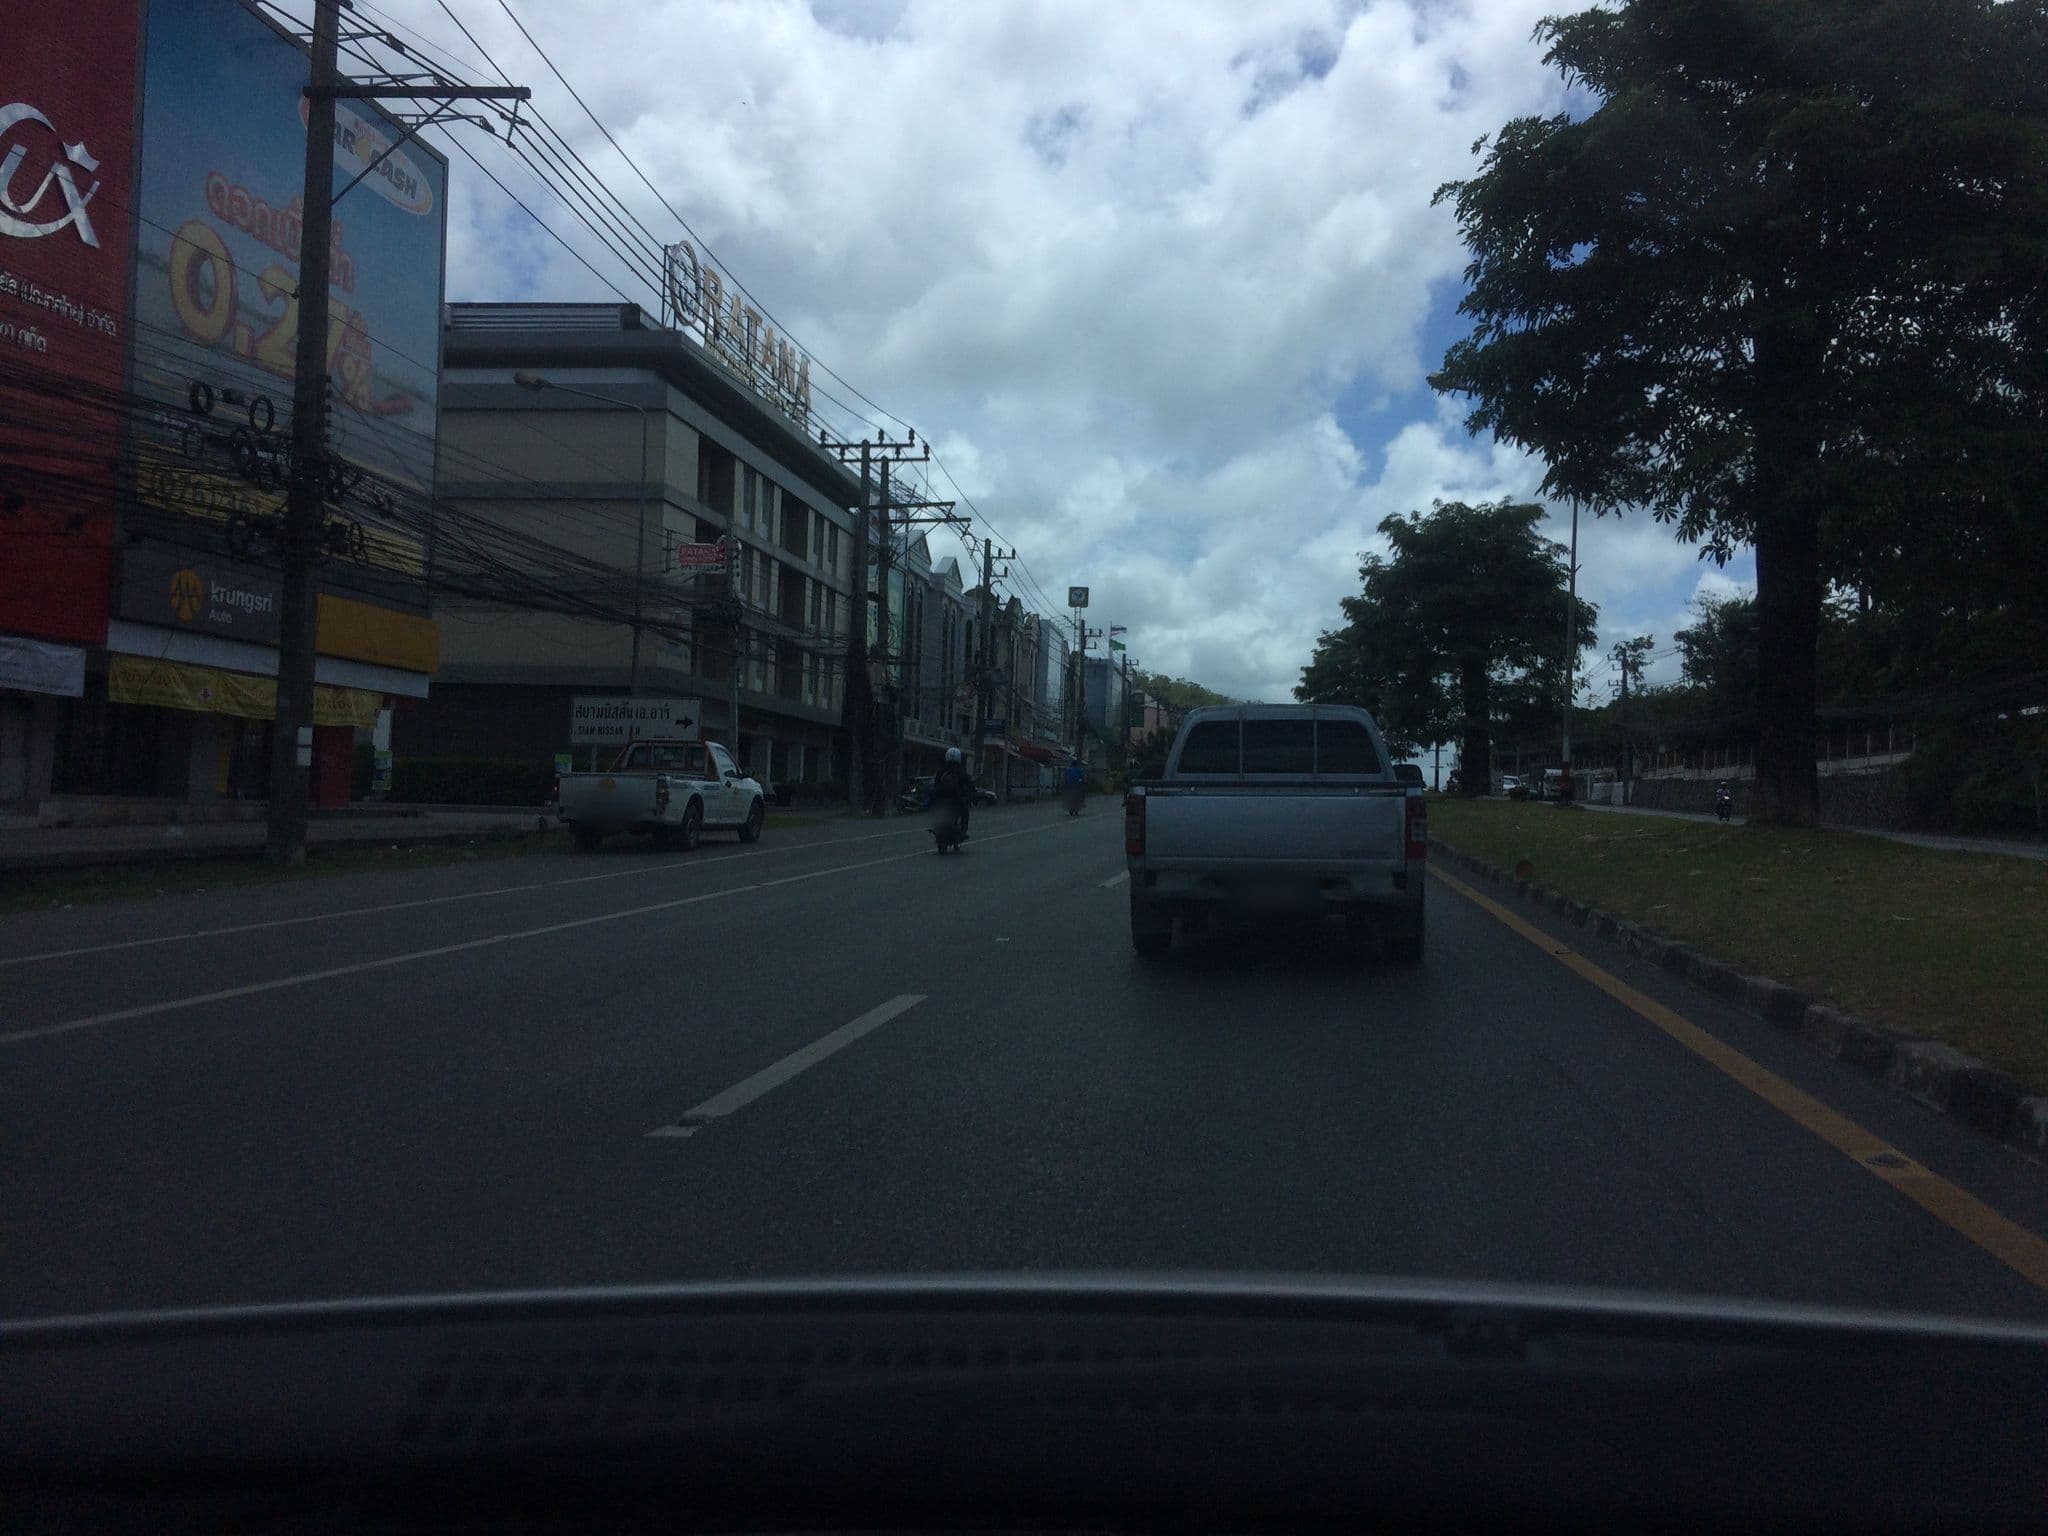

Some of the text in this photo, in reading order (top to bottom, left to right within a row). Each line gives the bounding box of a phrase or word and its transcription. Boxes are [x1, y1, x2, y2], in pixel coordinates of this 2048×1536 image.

[703, 262, 811, 412] RATANA
[210, 580, 273, 614] krungsri
[208, 608, 233, 624] Auto
